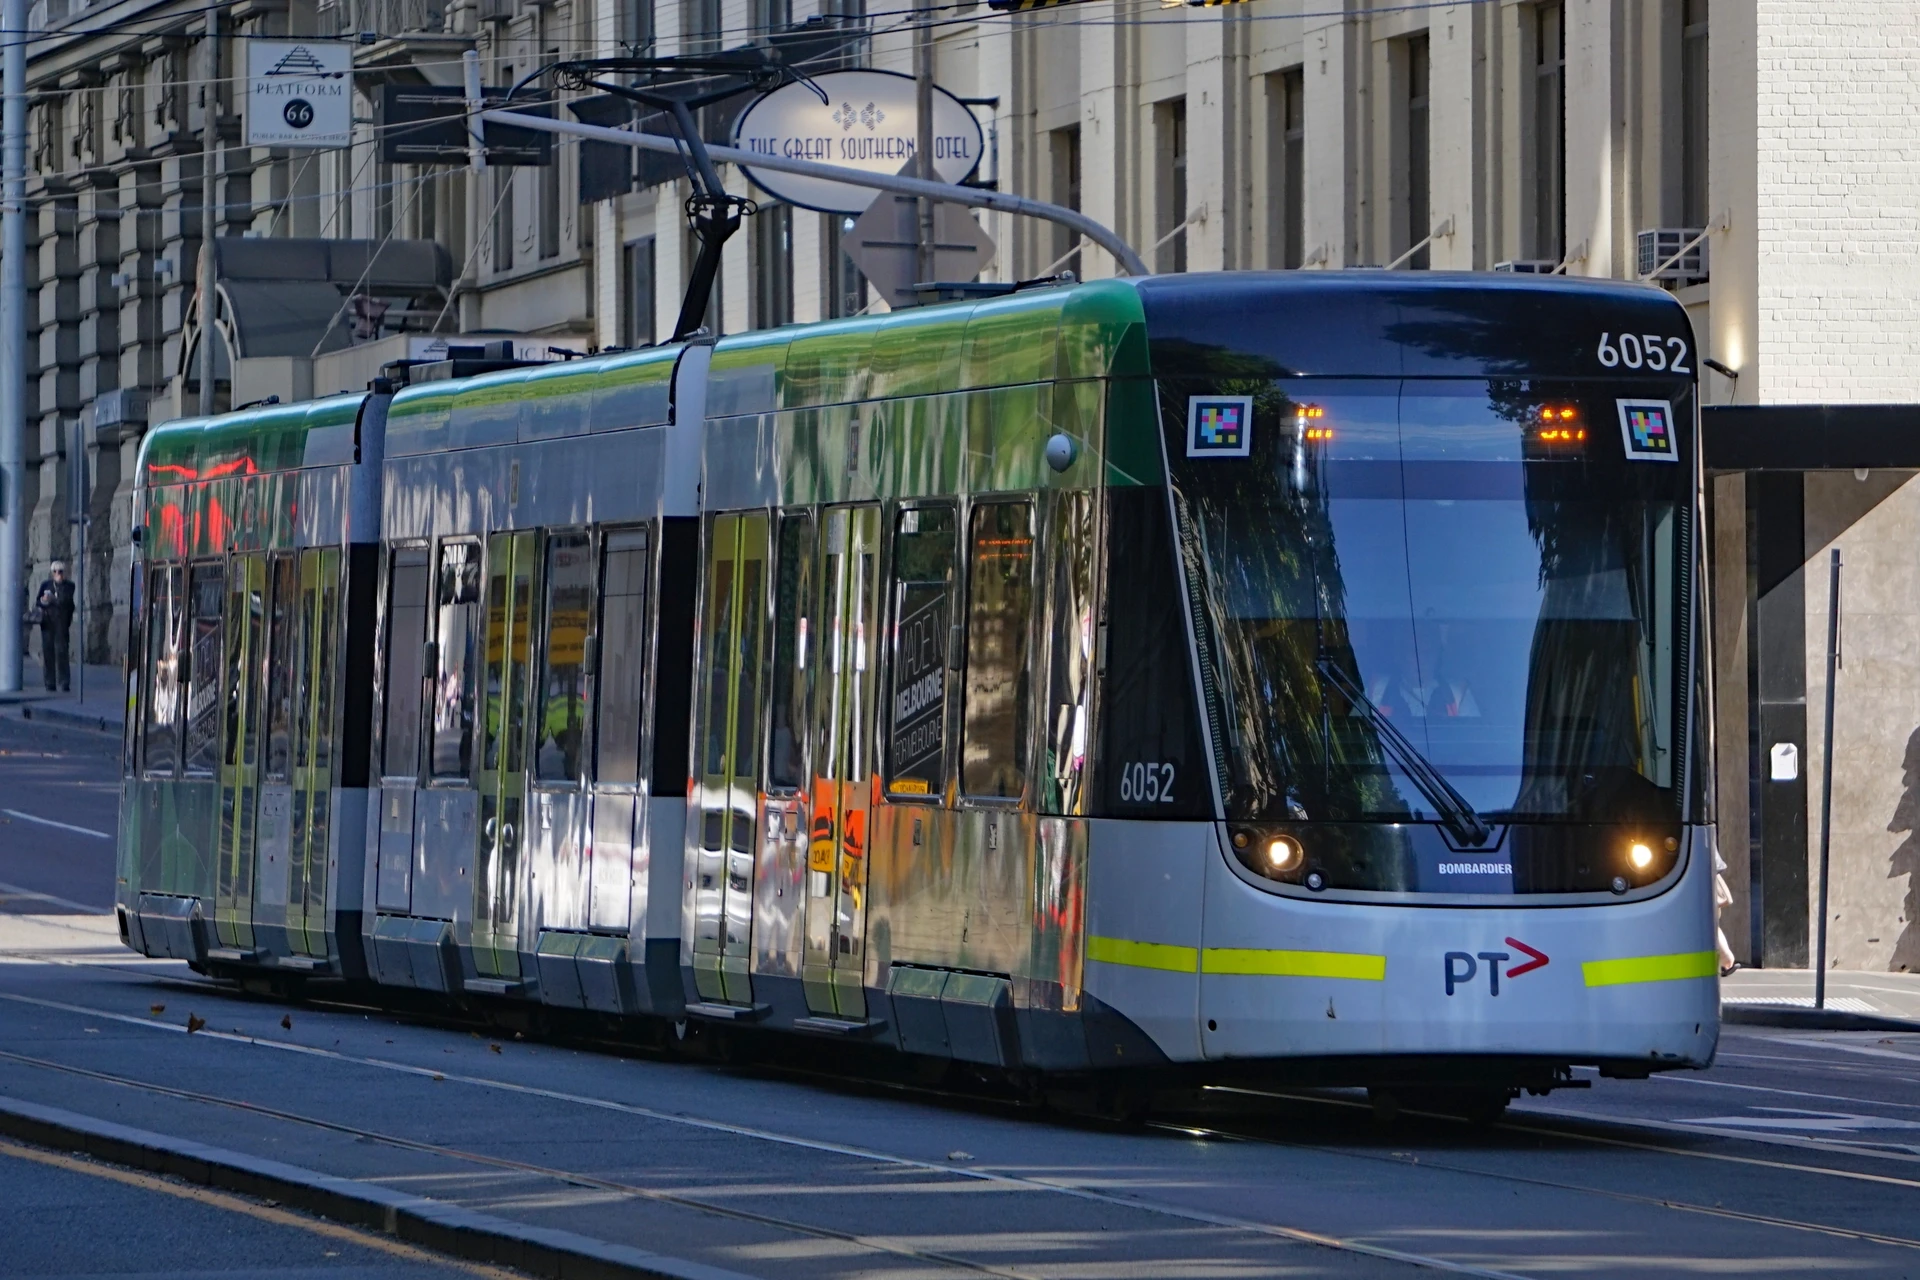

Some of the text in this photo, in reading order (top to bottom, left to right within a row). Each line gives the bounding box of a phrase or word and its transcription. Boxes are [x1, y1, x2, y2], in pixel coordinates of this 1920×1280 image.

[256, 82, 342, 96] PLATFORM
[286, 104, 311, 121] 66
[252, 132, 276, 140] PUBLIC
[279, 132, 293, 140] BAR
[749, 136, 970, 160] THE GREAT SOUTHERN OTEL
[1597, 331, 1691, 374] 6052
[896, 613, 931, 687] MADE
[896, 666, 943, 724] MELBOURNE
[894, 714, 942, 768] FOR MELBOURNE
[1120, 761, 1175, 803] 6052
[1438, 862, 1514, 875] BOMBARDIER
